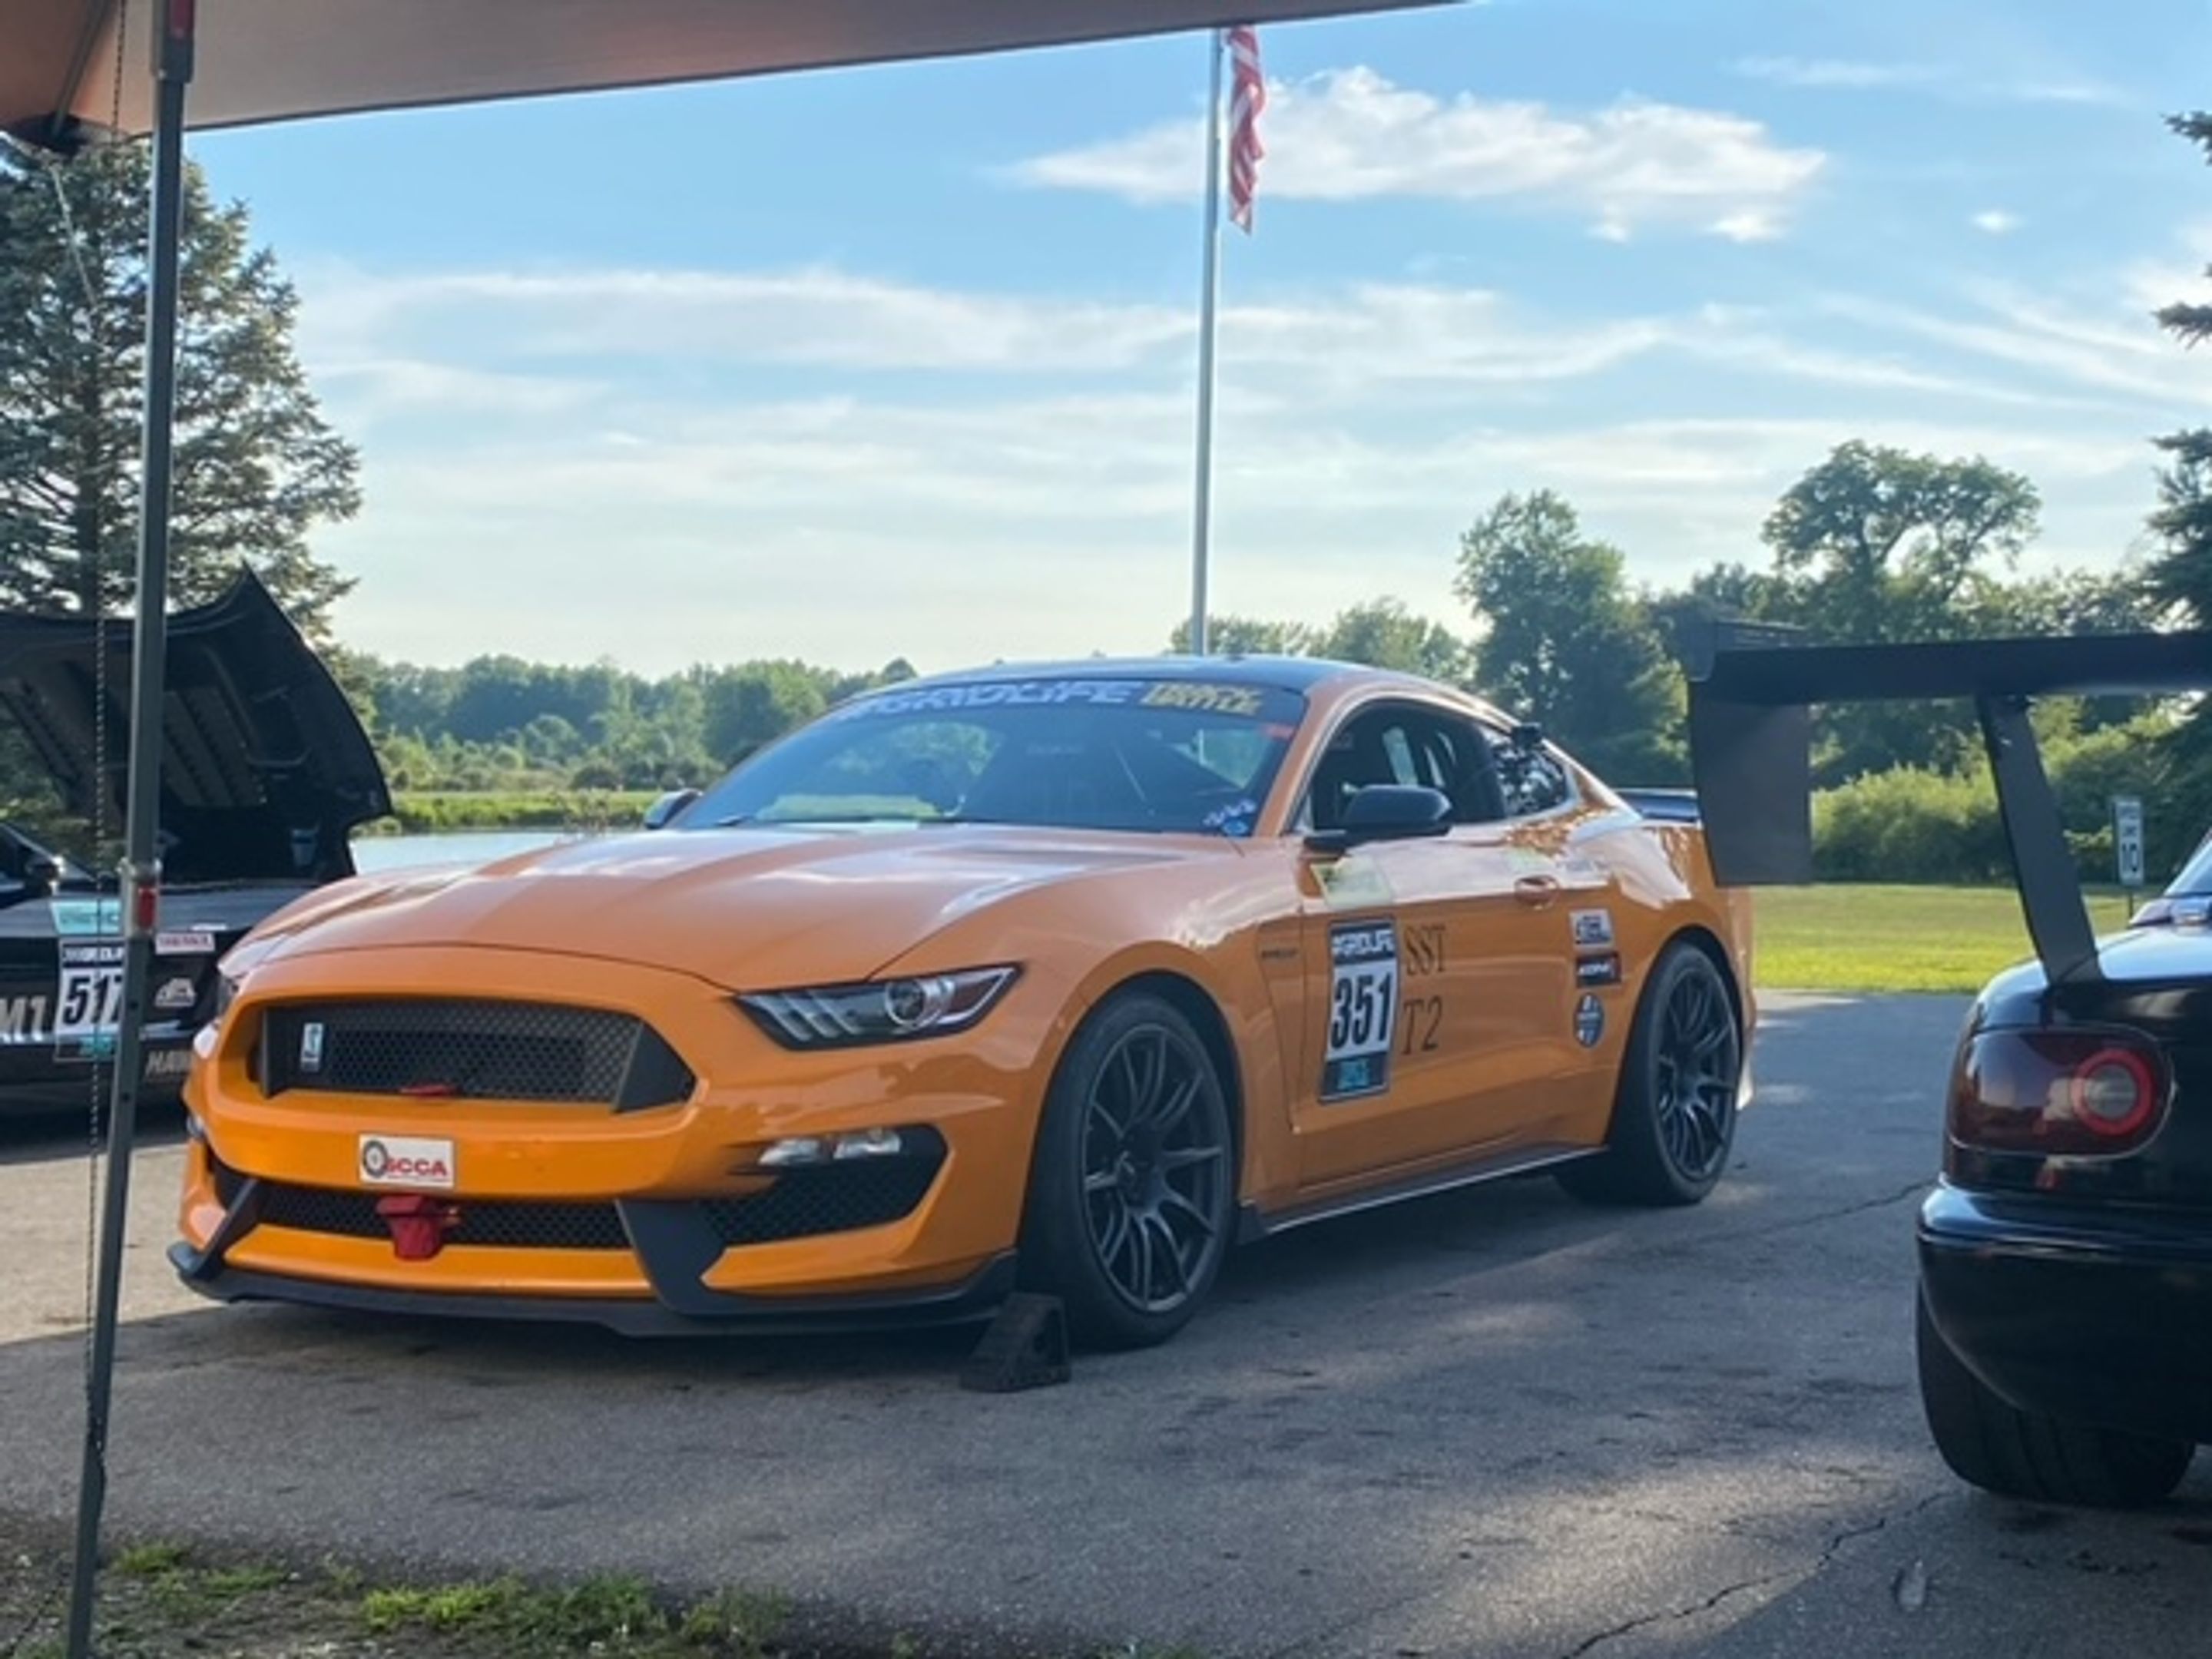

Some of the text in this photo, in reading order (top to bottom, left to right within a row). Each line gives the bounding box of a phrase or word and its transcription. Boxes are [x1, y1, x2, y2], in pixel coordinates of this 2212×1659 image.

[1405, 924, 1446, 975] SST
[1331, 972, 1392, 1050] 351
[1401, 995, 1443, 1055] T2
